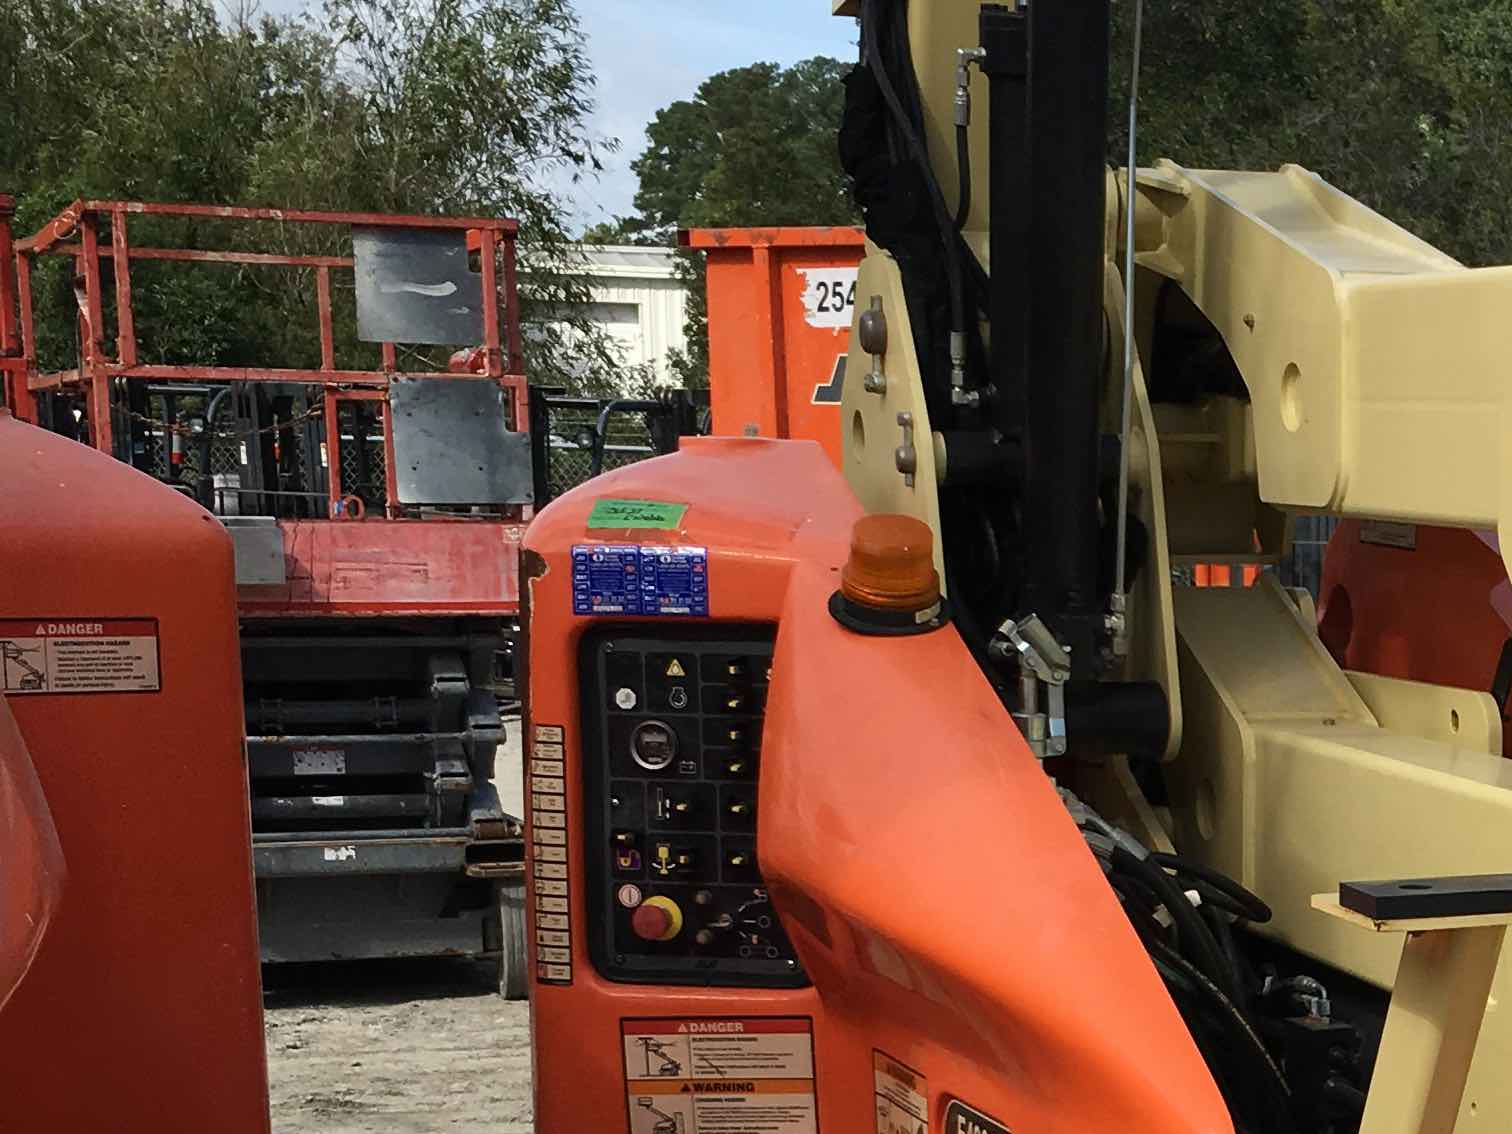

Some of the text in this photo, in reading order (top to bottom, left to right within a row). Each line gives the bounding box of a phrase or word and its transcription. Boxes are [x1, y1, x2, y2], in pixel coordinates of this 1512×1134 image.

[47, 623, 104, 635] DANGER
[689, 1022, 745, 1033] DANGER
[692, 1082, 756, 1093] WARNING
